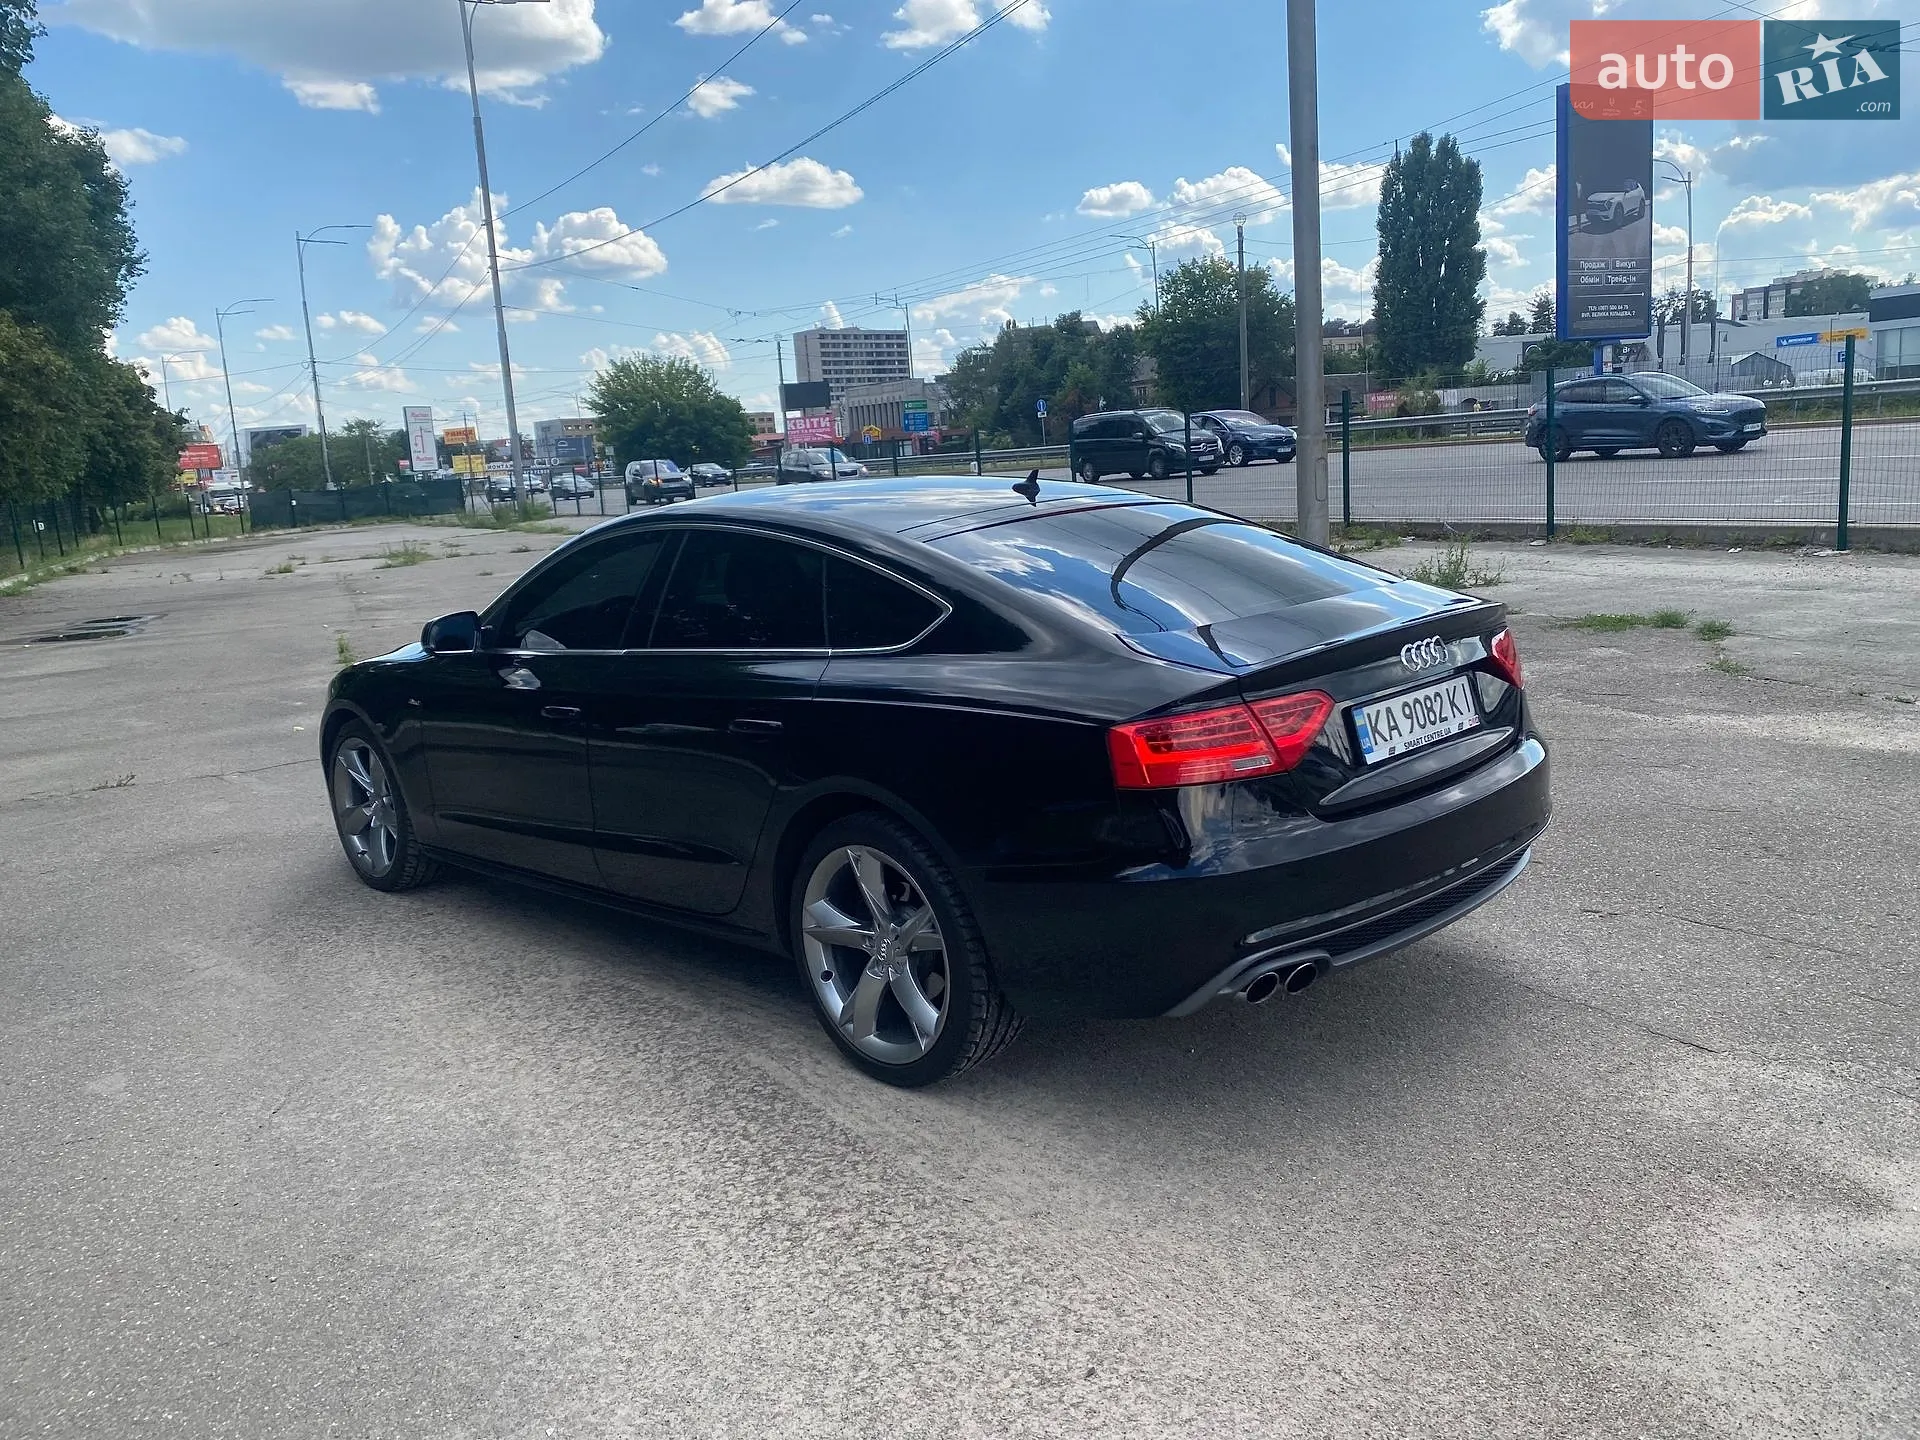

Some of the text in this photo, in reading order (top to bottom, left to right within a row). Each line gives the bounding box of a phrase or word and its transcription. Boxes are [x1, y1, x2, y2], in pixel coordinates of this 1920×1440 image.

[1580, 261, 1606, 271] Продаж
[1615, 260, 1636, 268] Викуп
[787, 417, 830, 430] КВІТИ
[1367, 683, 1470, 746] KA 9082 KI
[1403, 737, 1424, 749] SMART
